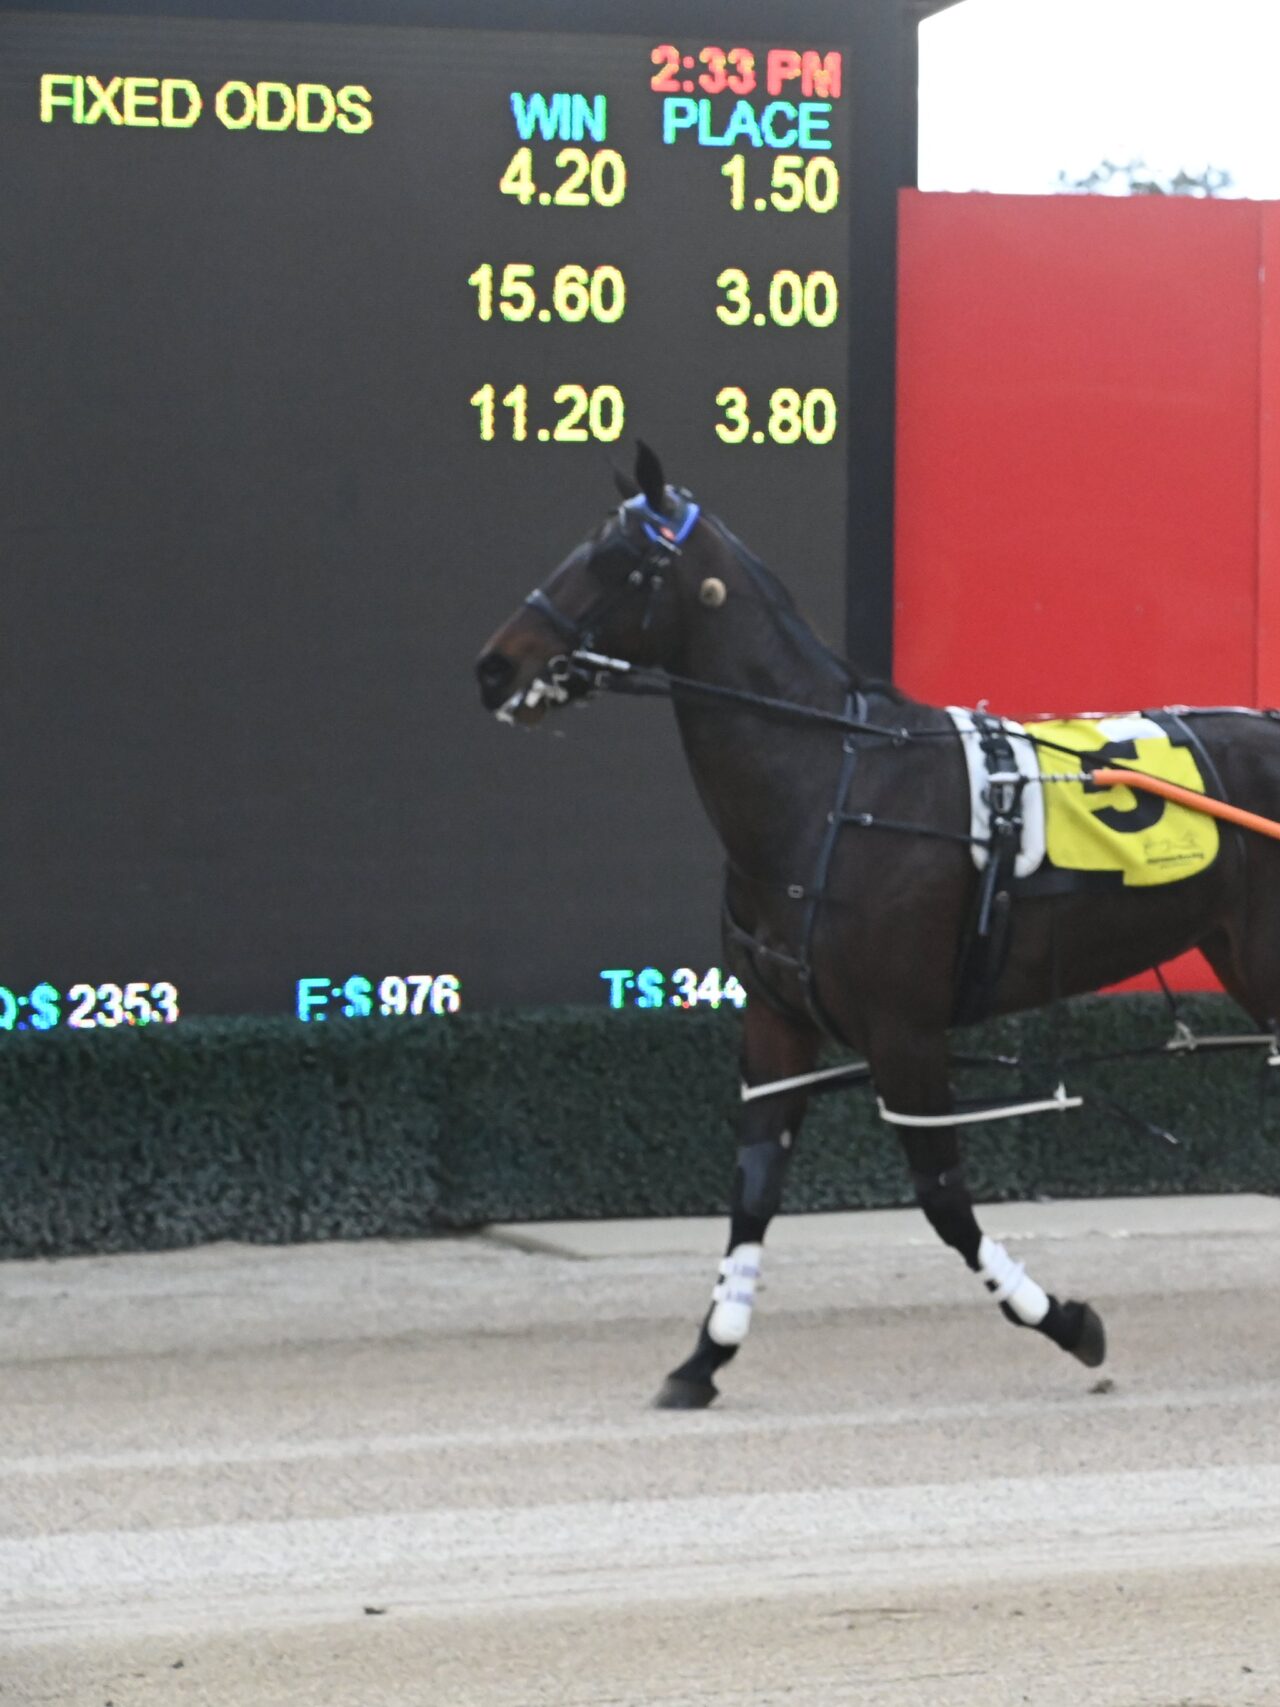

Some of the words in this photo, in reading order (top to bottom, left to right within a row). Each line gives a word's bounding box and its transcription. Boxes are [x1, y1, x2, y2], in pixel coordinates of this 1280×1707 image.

[651, 44, 757, 95] 2:33
[767, 49, 842, 98] PM
[40, 74, 203, 128] FIXED
[215, 81, 373, 134] ODDS
[510, 92, 606, 142] WIN
[662, 97, 833, 150] PLACE
[500, 148, 626, 207] 4.20
[721, 154, 839, 213] 1.50
[468, 264, 625, 323] 15.60
[716, 269, 838, 327] 3.00
[471, 384, 624, 442] 11.20
[716, 387, 836, 444] 3.80
